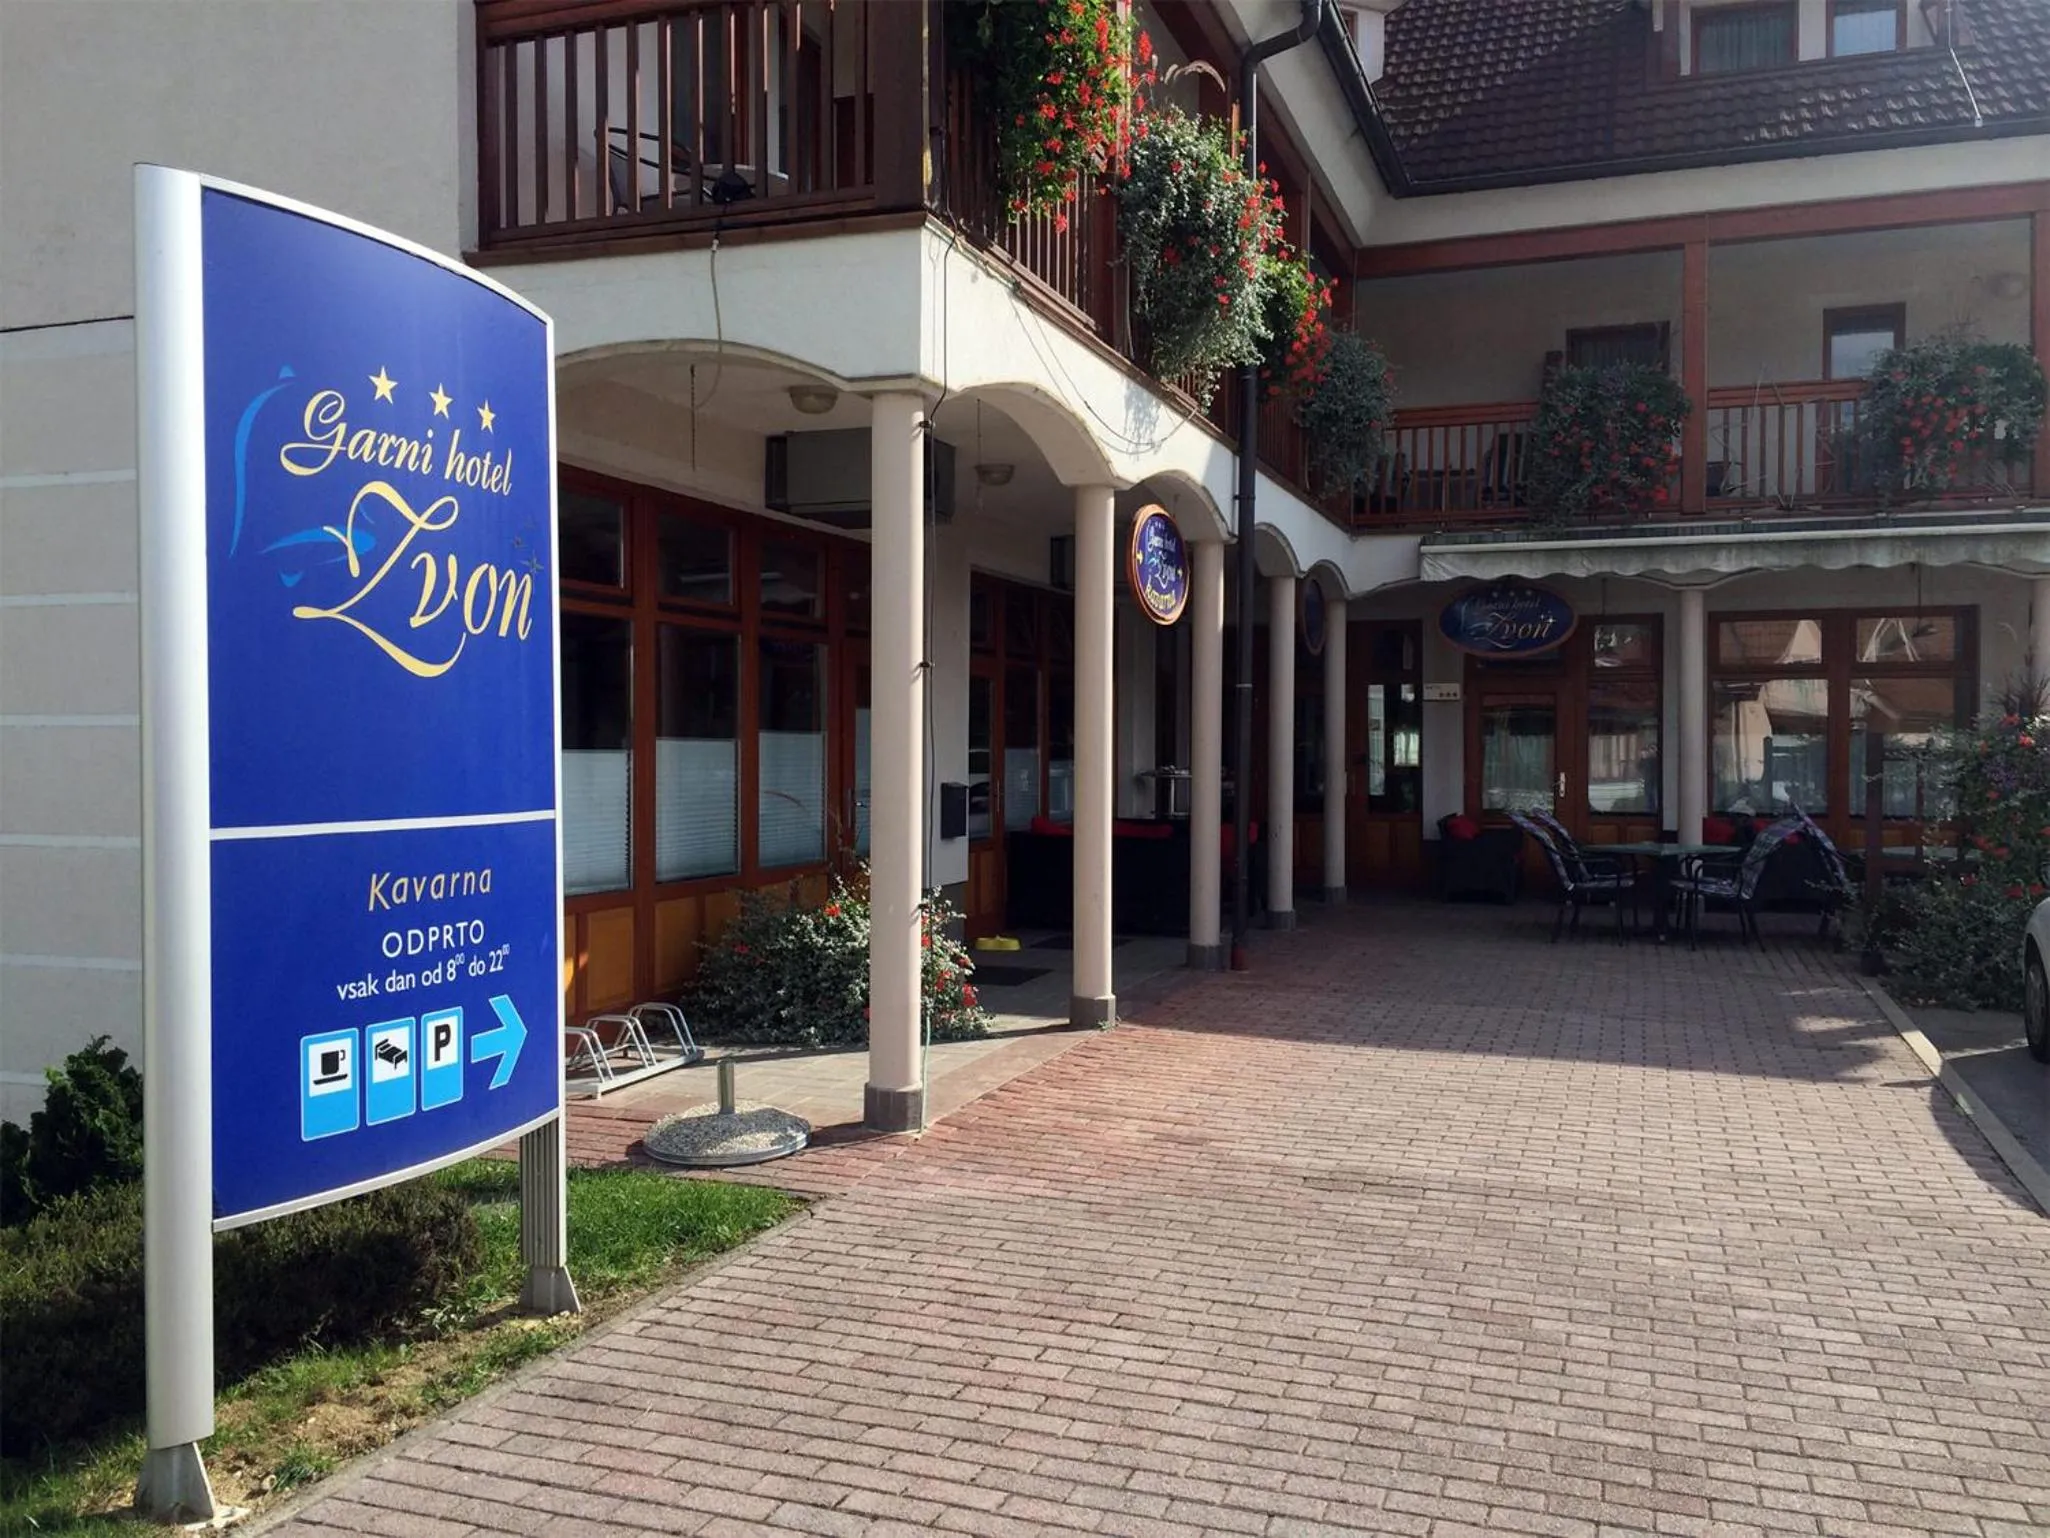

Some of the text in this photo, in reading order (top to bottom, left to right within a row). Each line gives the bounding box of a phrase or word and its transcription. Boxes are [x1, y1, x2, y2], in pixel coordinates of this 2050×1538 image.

[280, 390, 512, 496] Garni hotel
[293, 480, 533, 678] Zvon
[1474, 612, 1552, 649] Zvon
[368, 868, 492, 912] Kavarna
[382, 919, 485, 958] ODPRTO
[337, 973, 379, 1000] vsak
[385, 969, 416, 992] dan
[421, 961, 442, 987] od
[468, 956, 486, 977] do
[434, 1023, 451, 1062] P
